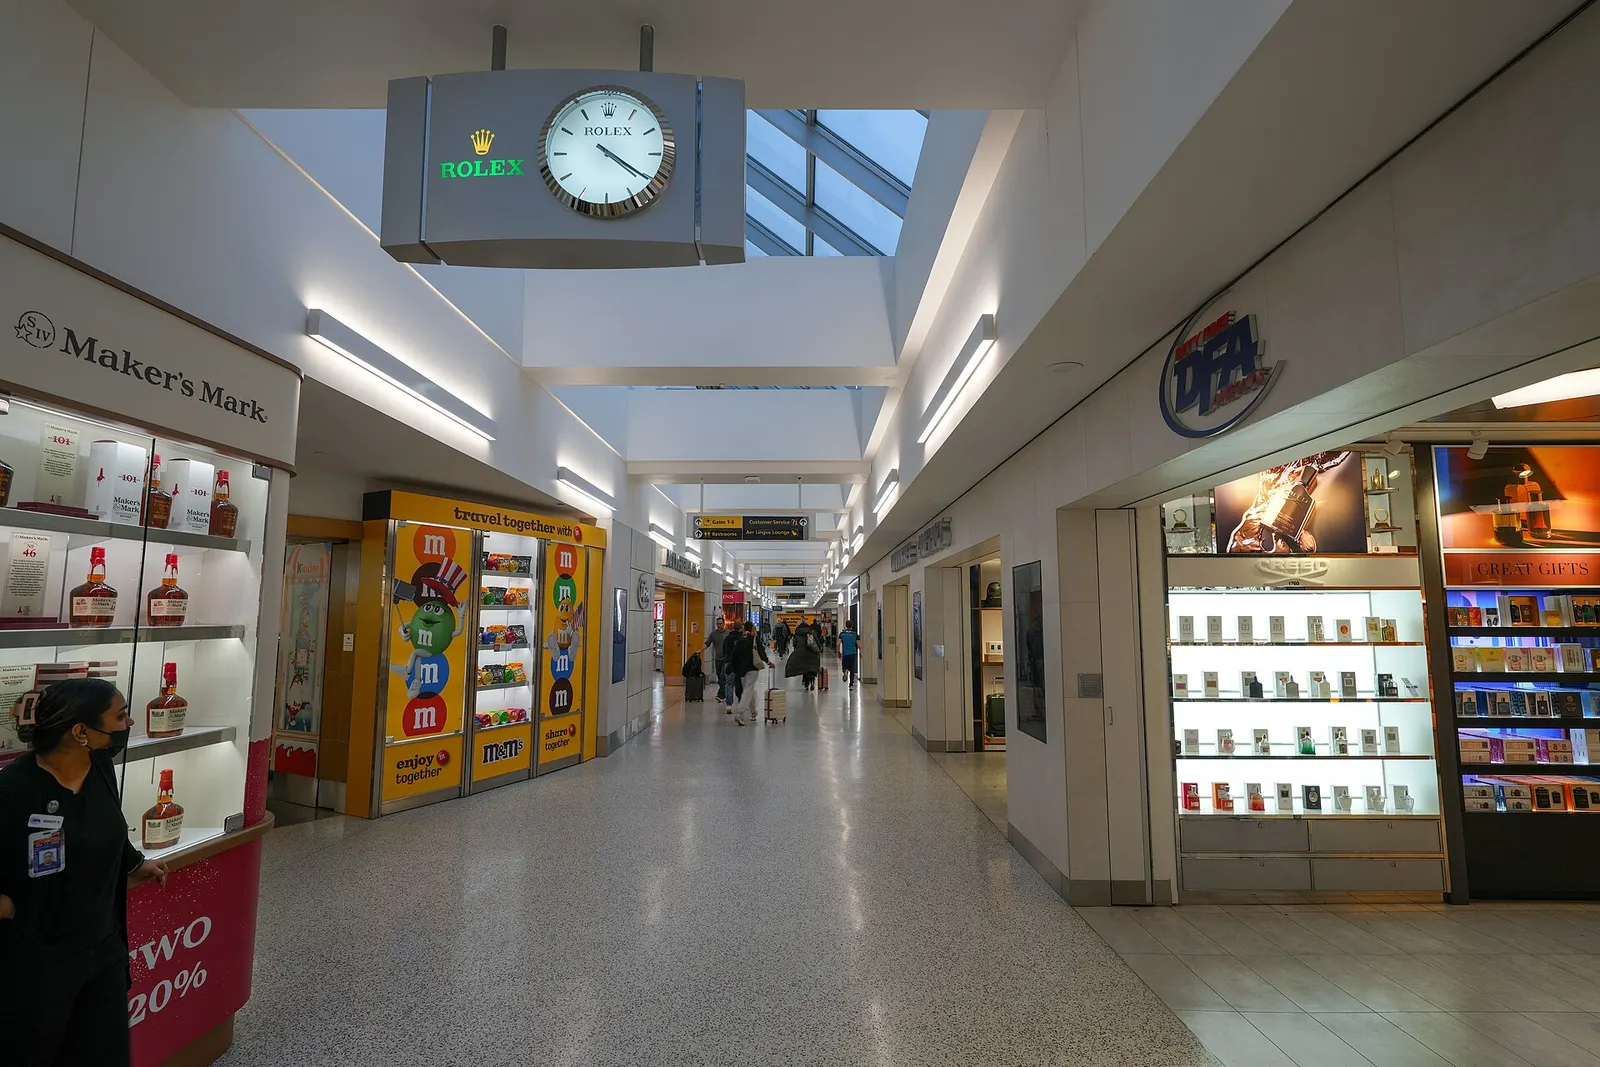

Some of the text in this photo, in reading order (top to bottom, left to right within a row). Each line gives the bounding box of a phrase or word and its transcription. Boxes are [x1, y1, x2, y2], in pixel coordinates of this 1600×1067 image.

[584, 127, 632, 136] ROLEX
[440, 159, 525, 179] ROLEX
[1173, 313, 1262, 416] DFA
[59, 326, 267, 424] Maker's Mark
[52, 435, 71, 446] 101
[122, 474, 137, 484] 101
[194, 489, 207, 497] 101
[120, 505, 140, 513] Mark
[192, 516, 209, 524] Mark
[453, 506, 502, 526] travel
[503, 515, 556, 534] together
[556, 525, 573, 538] with
[423, 534, 446, 556] m
[22, 548, 37, 558] 46
[1257, 559, 1328, 573] CREED
[1477, 562, 1589, 576] GREAT GIFTS
[413, 706, 437, 730] m
[545, 729, 568, 740] share
[544, 737, 570, 752] together
[396, 754, 435, 770] enjoy
[395, 767, 442, 785] together
[128, 916, 212, 971] WO
[127, 960, 207, 1029] 20%
